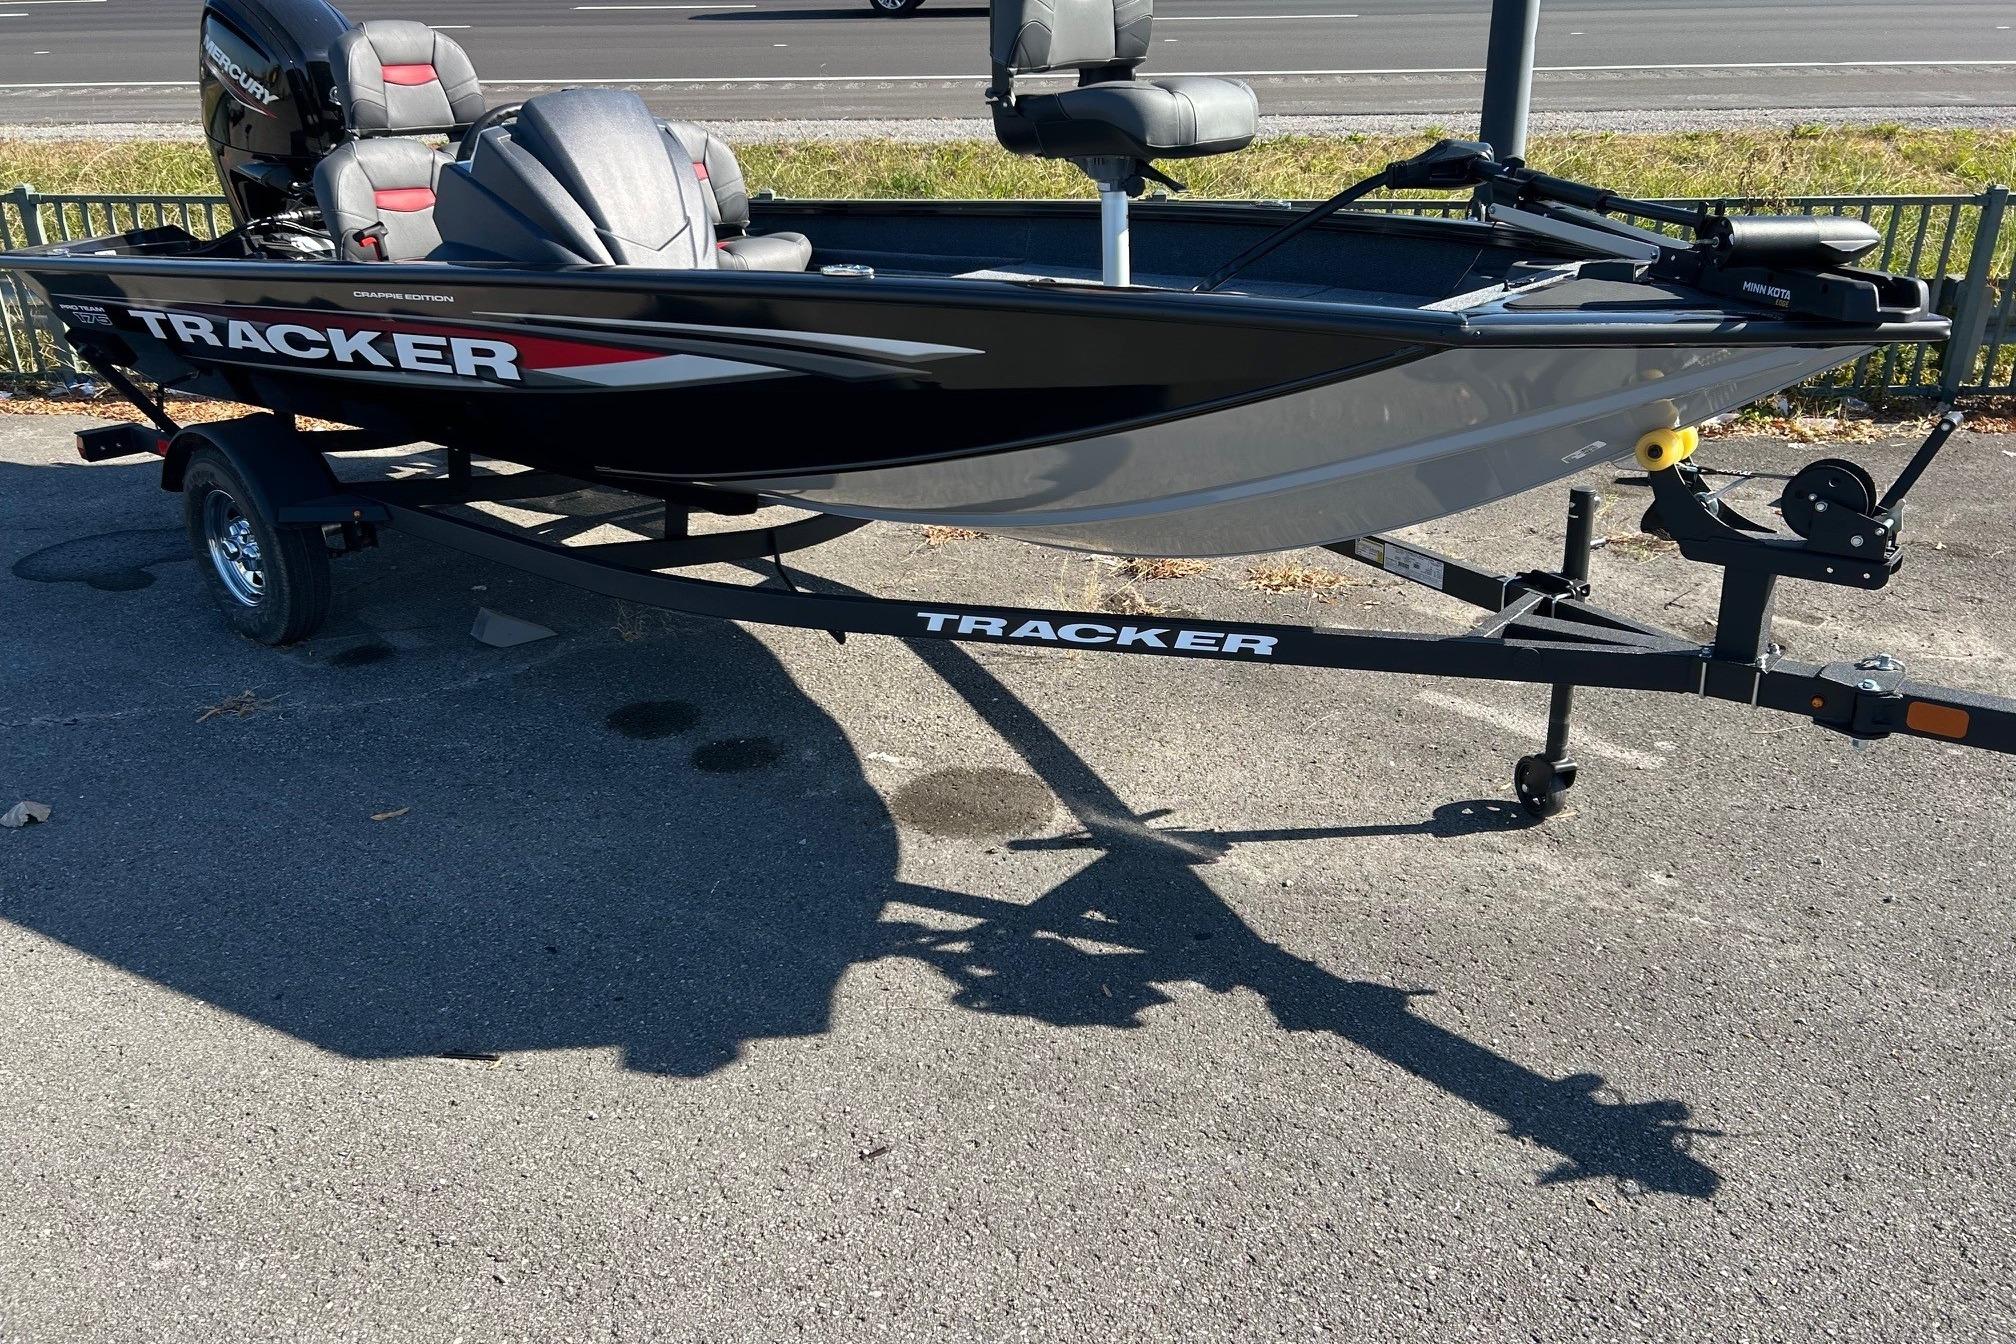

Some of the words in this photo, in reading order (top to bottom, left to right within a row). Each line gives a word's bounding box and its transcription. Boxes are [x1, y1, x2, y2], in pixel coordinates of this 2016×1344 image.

[203, 33, 280, 105] MERCURY
[353, 291, 403, 300] CRAPPIE
[404, 293, 455, 302] EDITION
[1742, 280, 1767, 294] MINN
[1767, 286, 1791, 300] KOTA
[72, 311, 113, 326] 175
[127, 309, 521, 380] TRACKER
[917, 612, 1279, 656] TRACKER
